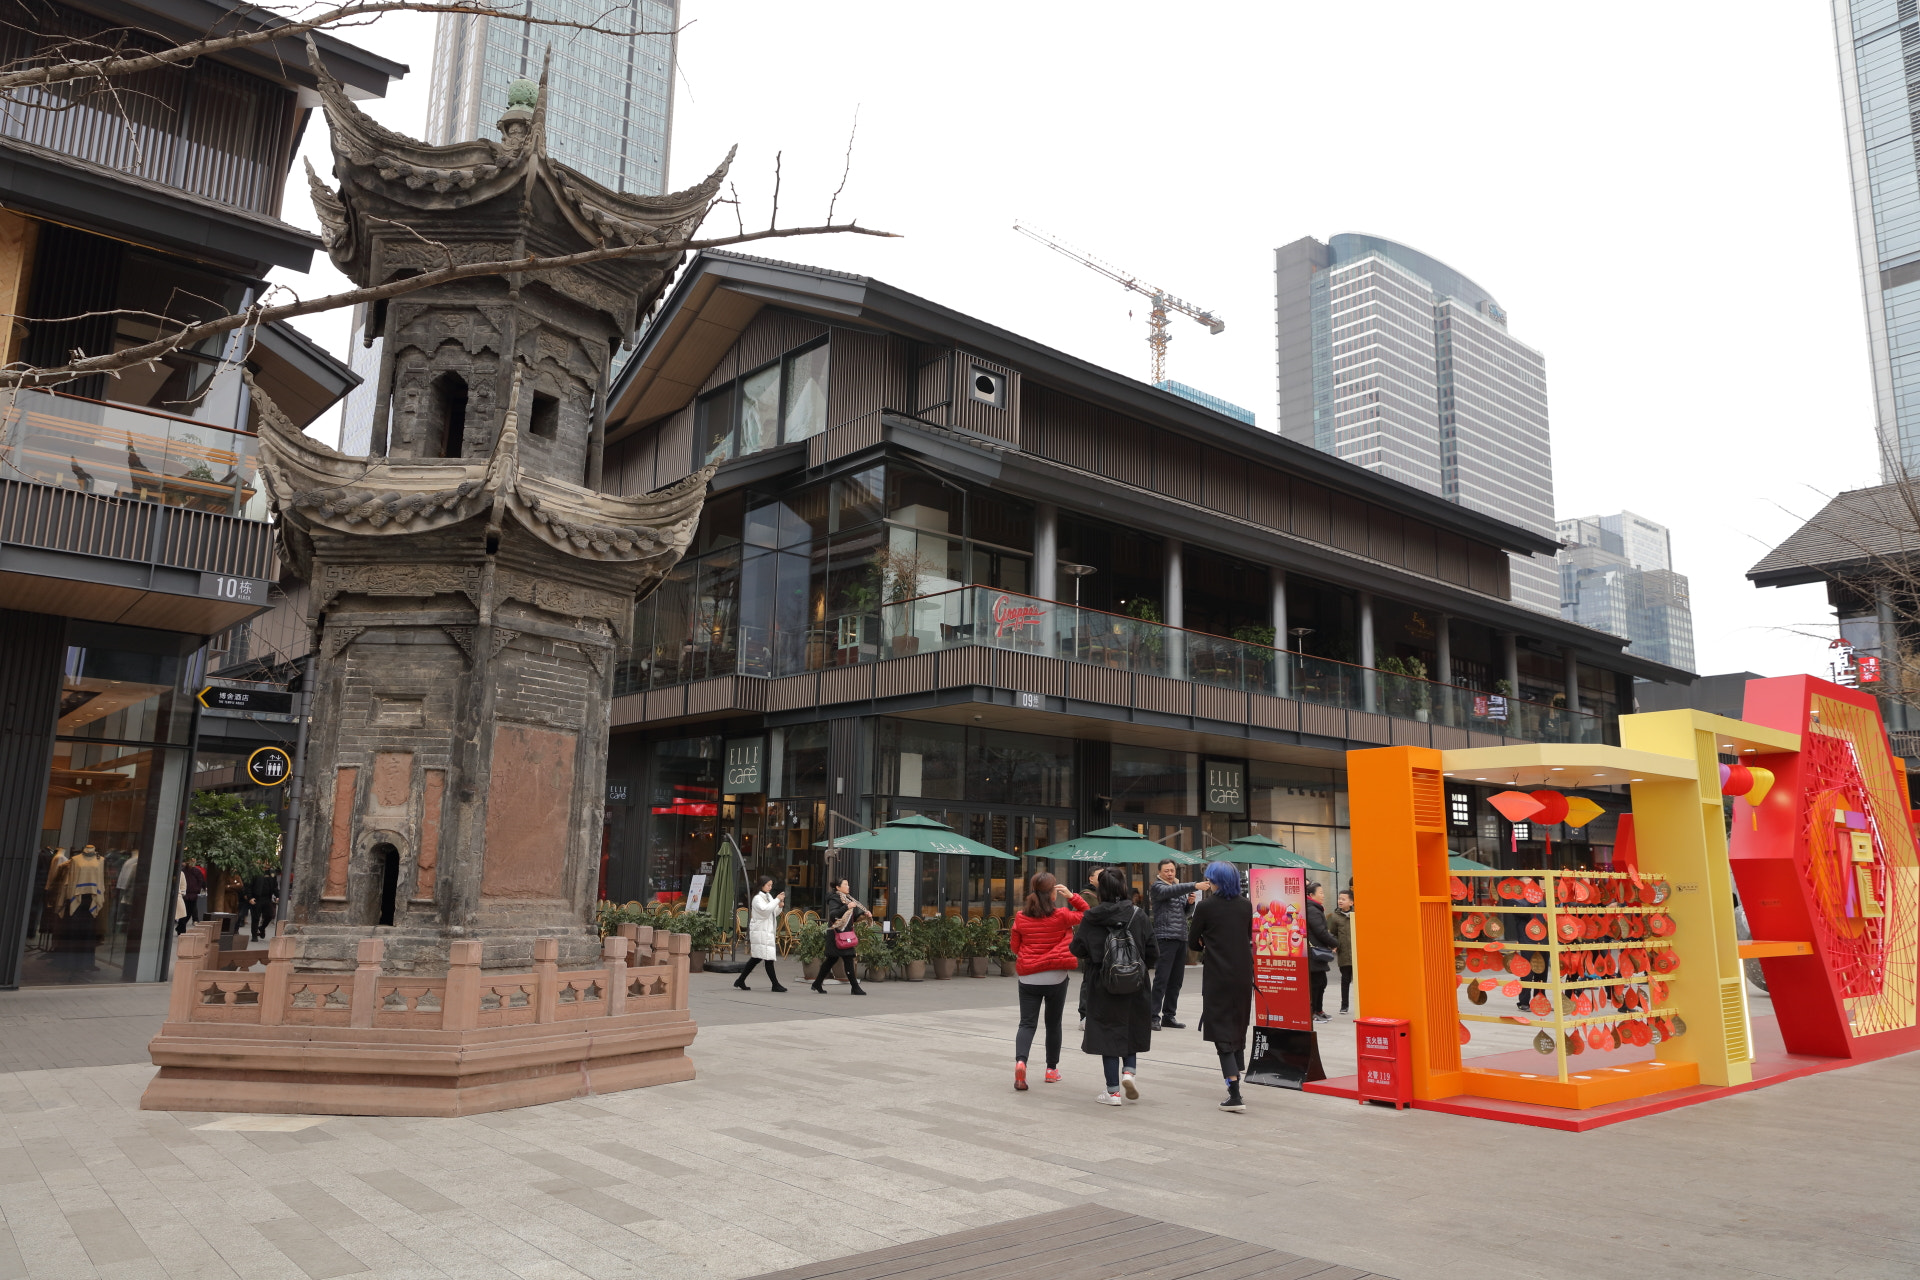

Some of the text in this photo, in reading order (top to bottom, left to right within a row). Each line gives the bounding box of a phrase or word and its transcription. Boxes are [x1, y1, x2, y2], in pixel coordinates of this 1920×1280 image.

[217, 577, 252, 598] 10栋
[730, 746, 759, 766] ELLE
[1210, 769, 1240, 788] ELLE
[610, 785, 627, 793] ELLE
[1075, 849, 1110, 858] ELLE
[1365, 1036, 1389, 1046] 灭火器箱
[1380, 1071, 1391, 1081] 119
